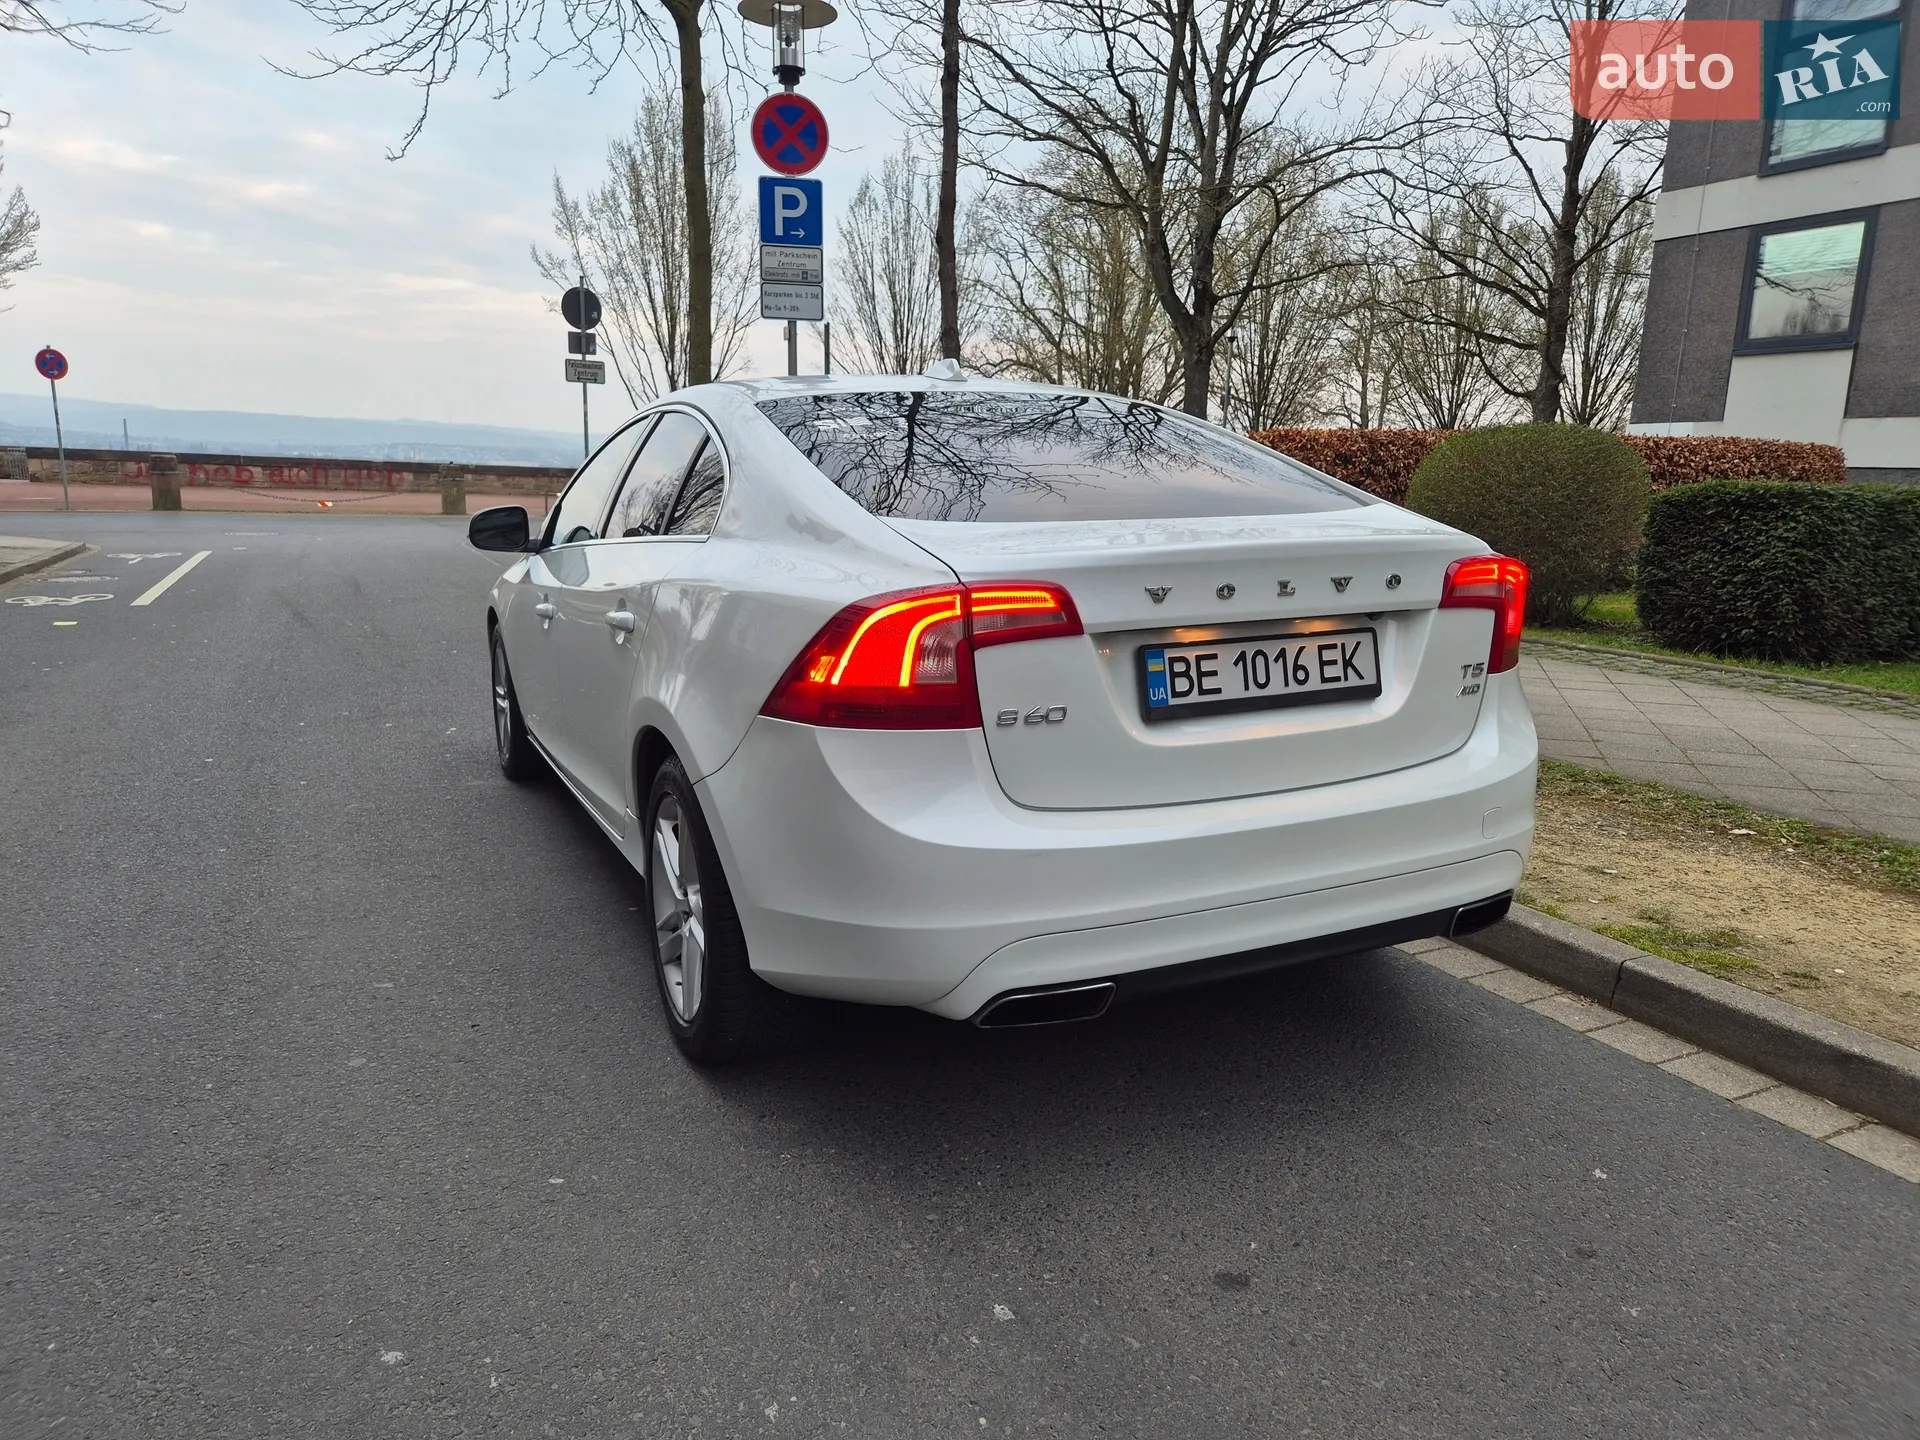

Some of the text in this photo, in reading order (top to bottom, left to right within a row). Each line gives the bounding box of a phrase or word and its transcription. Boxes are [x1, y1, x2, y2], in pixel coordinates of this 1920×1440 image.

[774, 186, 808, 236] P
[779, 250, 818, 260] Parkschein
[777, 260, 807, 268] Zentrum
[764, 290, 794, 299] Kurzparken
[794, 291, 804, 299] bis
[573, 369, 599, 378] Zentrum
[1145, 572, 1402, 604] VOLVO
[1168, 640, 1365, 699] BE 1016 EK
[1461, 662, 1485, 679] T5
[1150, 687, 1167, 700] UA
